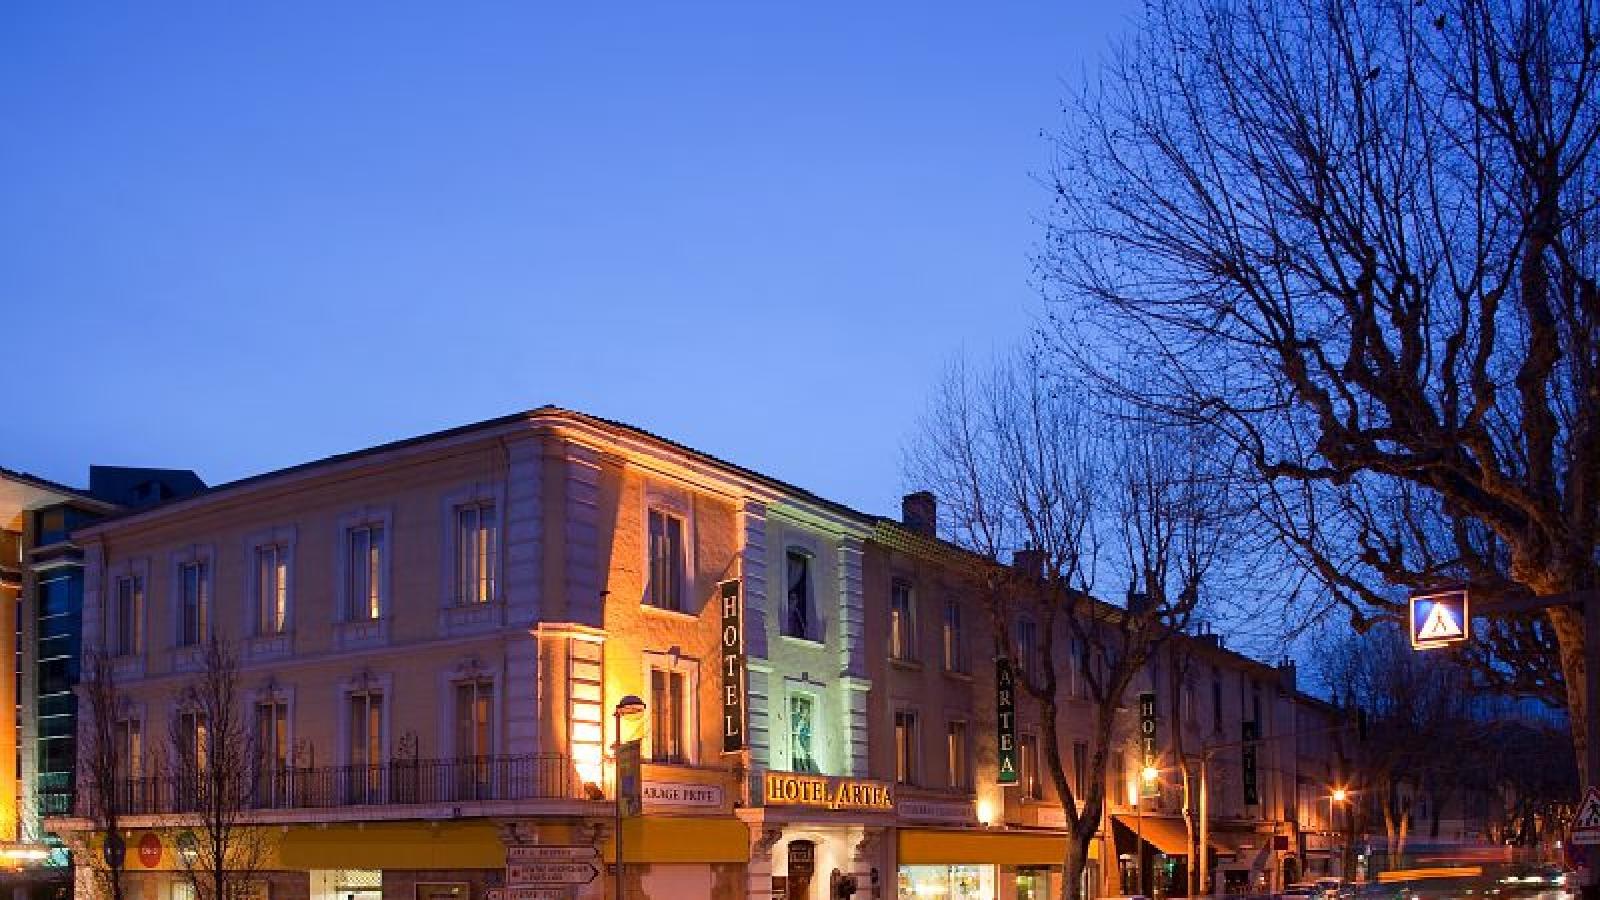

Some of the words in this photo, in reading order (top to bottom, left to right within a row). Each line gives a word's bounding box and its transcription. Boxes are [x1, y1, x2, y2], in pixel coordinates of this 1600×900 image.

[723, 595, 739, 737] HOTEL
[999, 670, 1014, 773] ARTEA
[771, 776, 834, 803] HOTEL
[838, 782, 895, 807] ARTEA
